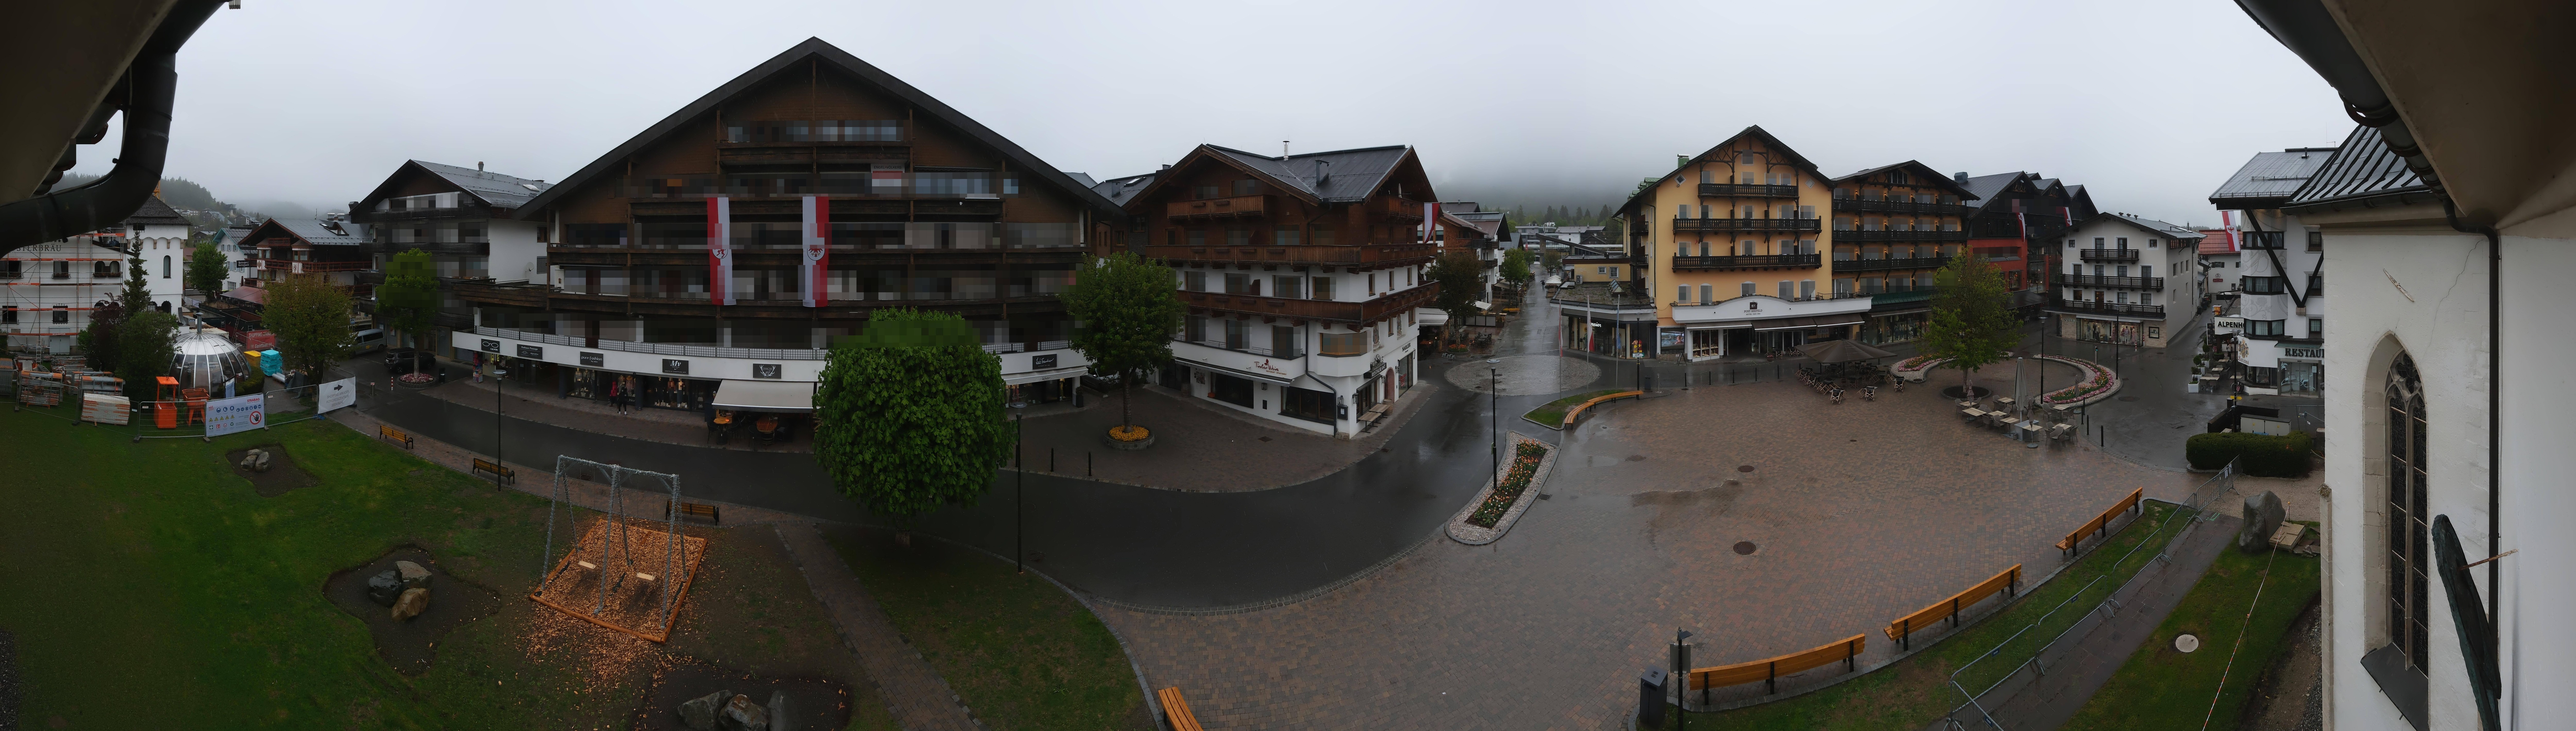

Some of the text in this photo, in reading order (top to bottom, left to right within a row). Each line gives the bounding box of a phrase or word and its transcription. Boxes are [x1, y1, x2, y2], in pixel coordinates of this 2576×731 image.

[1402, 343, 1411, 351] SAILER
[670, 360, 681, 370] My
[1372, 364, 1386, 377] RESTAURANT
[326, 395, 349, 403] KONGRESSZENTRUM
